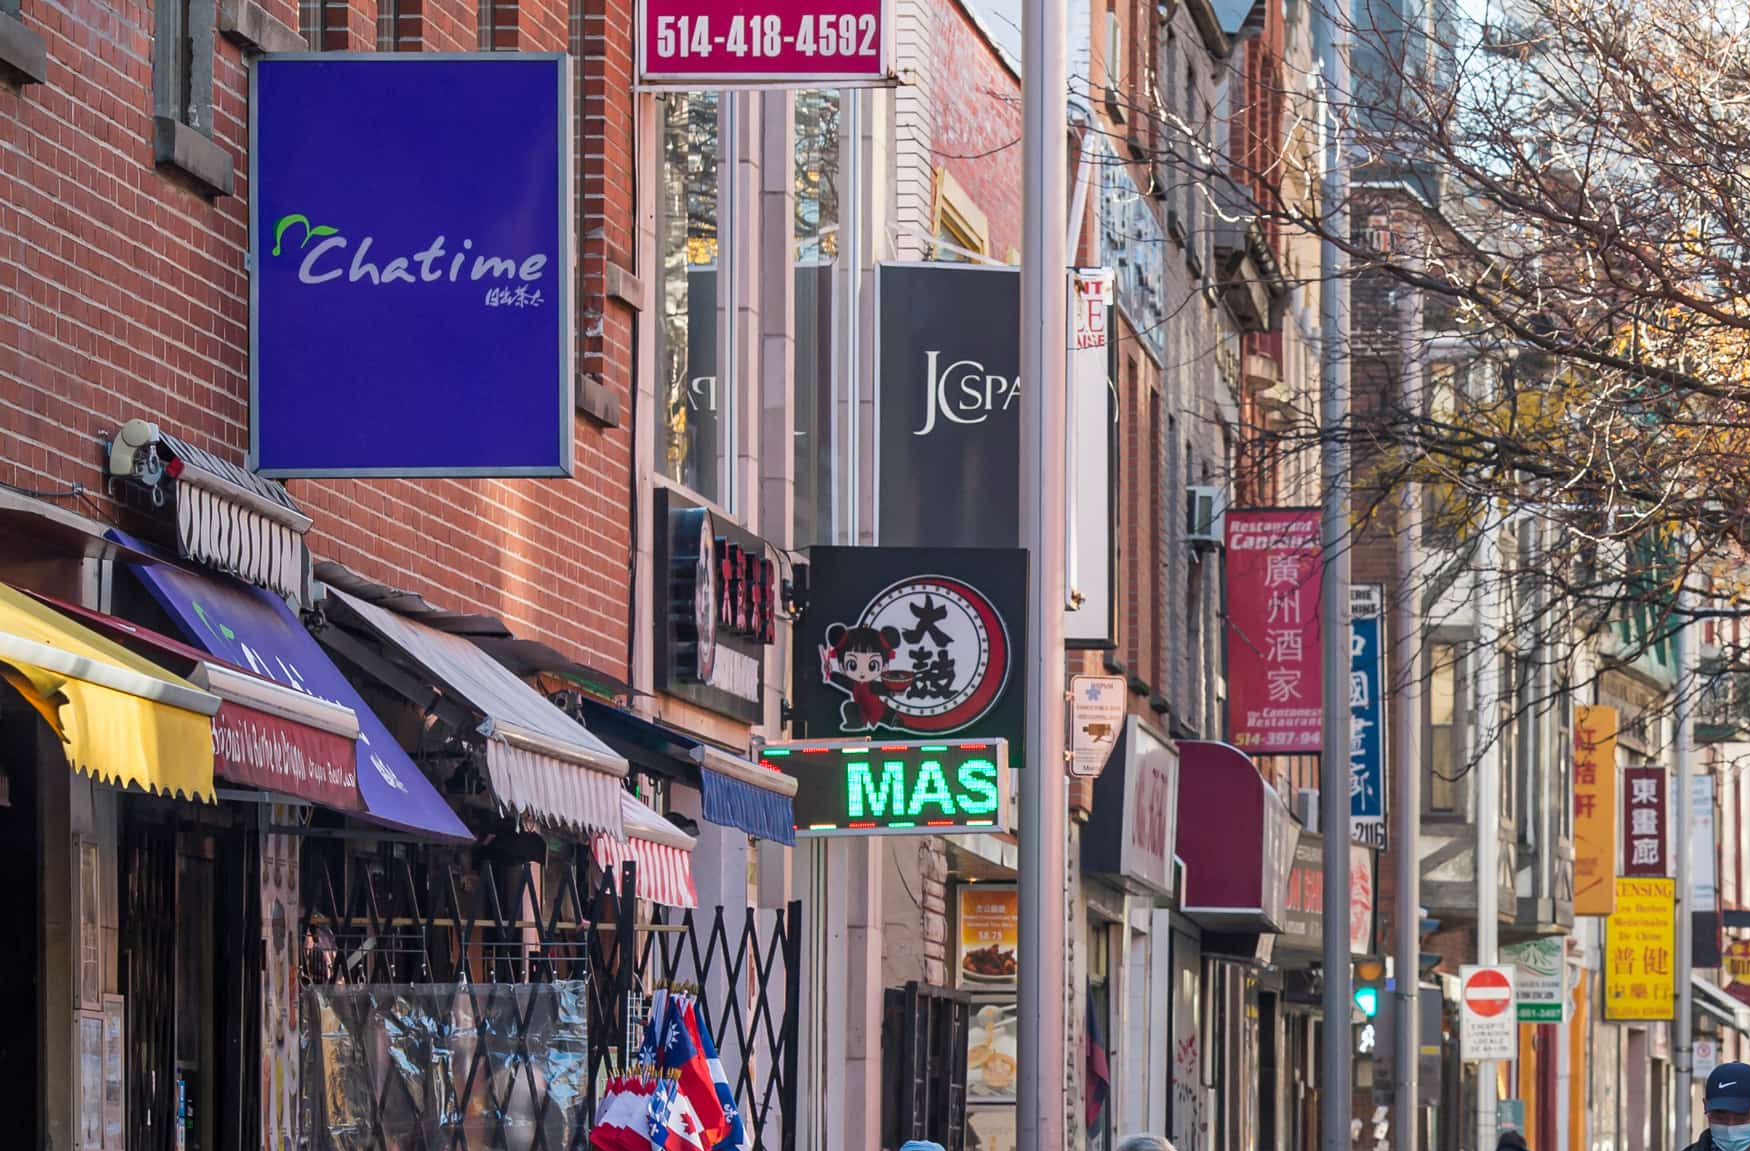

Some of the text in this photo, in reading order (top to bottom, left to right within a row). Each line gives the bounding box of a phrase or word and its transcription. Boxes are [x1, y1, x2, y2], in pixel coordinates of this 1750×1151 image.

[656, 14, 877, 58] 514-418-4592
[298, 235, 548, 285] Chatime
[1229, 520, 1313, 533] Restaurant
[902, 592, 959, 700] 大鼓
[1263, 554, 1303, 703] 廣州酒家
[846, 759, 998, 817] MAS
